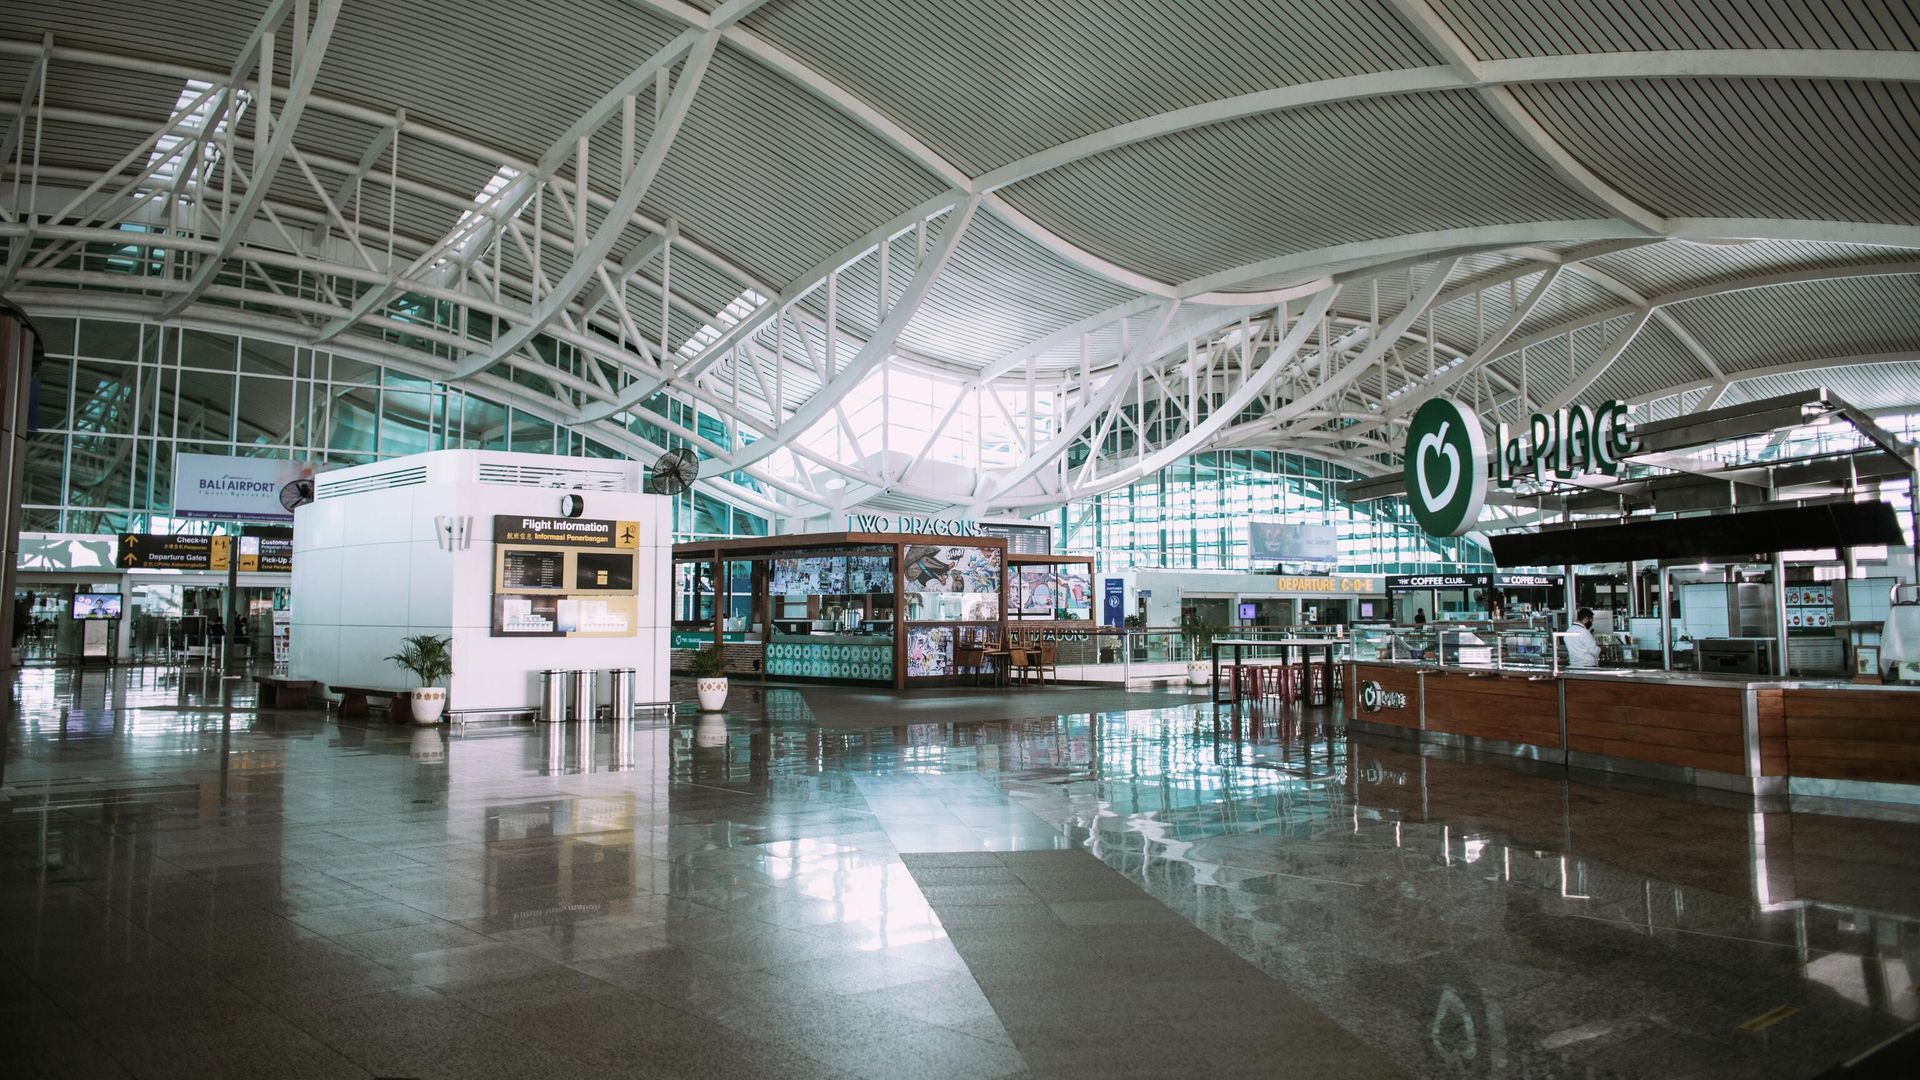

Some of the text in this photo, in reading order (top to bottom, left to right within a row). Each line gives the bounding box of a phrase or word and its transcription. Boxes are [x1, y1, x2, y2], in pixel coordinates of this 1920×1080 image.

[199, 479, 275, 493] BALI AIRPORT
[522, 518, 608, 532] Flight Information
[846, 514, 982, 538] TWO DRAGONS
[176, 536, 208, 544] Check-In
[534, 533, 566, 541] Informasi
[566, 535, 608, 544] Penerbangan
[148, 553, 185, 561] Departure
[261, 556, 288, 565] Pick-Up
[1278, 577, 1336, 591] DEPARTURE
[1410, 577, 1443, 585] COFFEE
[1511, 576, 1534, 584] COFFEE
